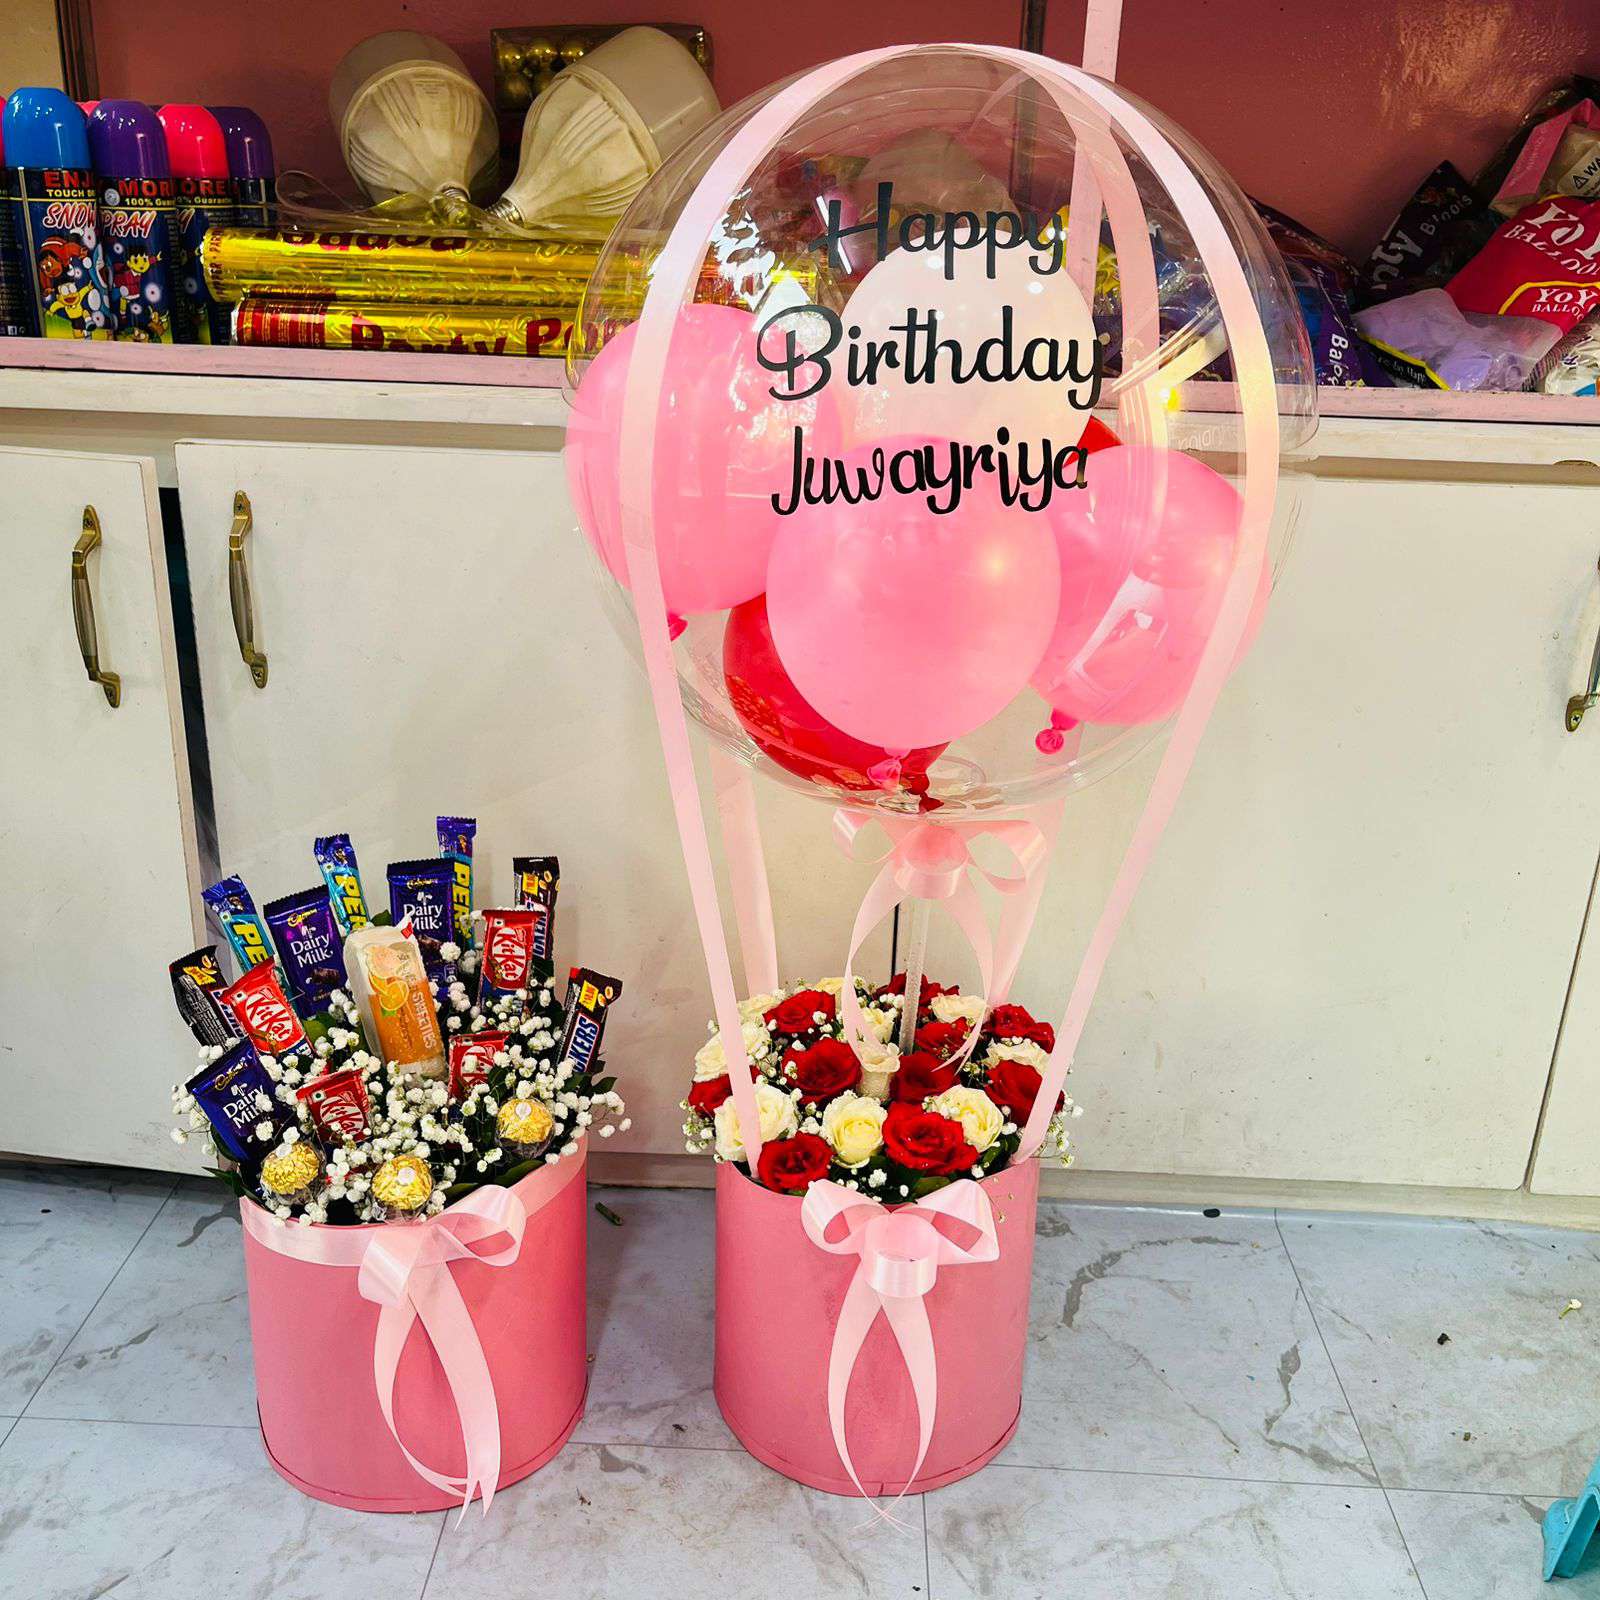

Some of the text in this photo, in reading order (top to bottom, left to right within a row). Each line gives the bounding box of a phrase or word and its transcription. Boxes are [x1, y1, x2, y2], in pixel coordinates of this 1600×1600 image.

[44, 170, 94, 188] ENJ
[46, 189, 85, 197] TOUCH
[808, 182, 1065, 280] Happy
[757, 305, 1102, 409] Birthday
[771, 426, 1088, 515] Juwayriya
[403, 903, 443, 918] Dairy
[290, 933, 330, 955] Dairy
[297, 947, 334, 968] Milk
[492, 931, 527, 980] KitKat
[246, 996, 291, 1039] KitKat
[223, 1084, 264, 1119] Dairy
[232, 1103, 261, 1129] Mil
